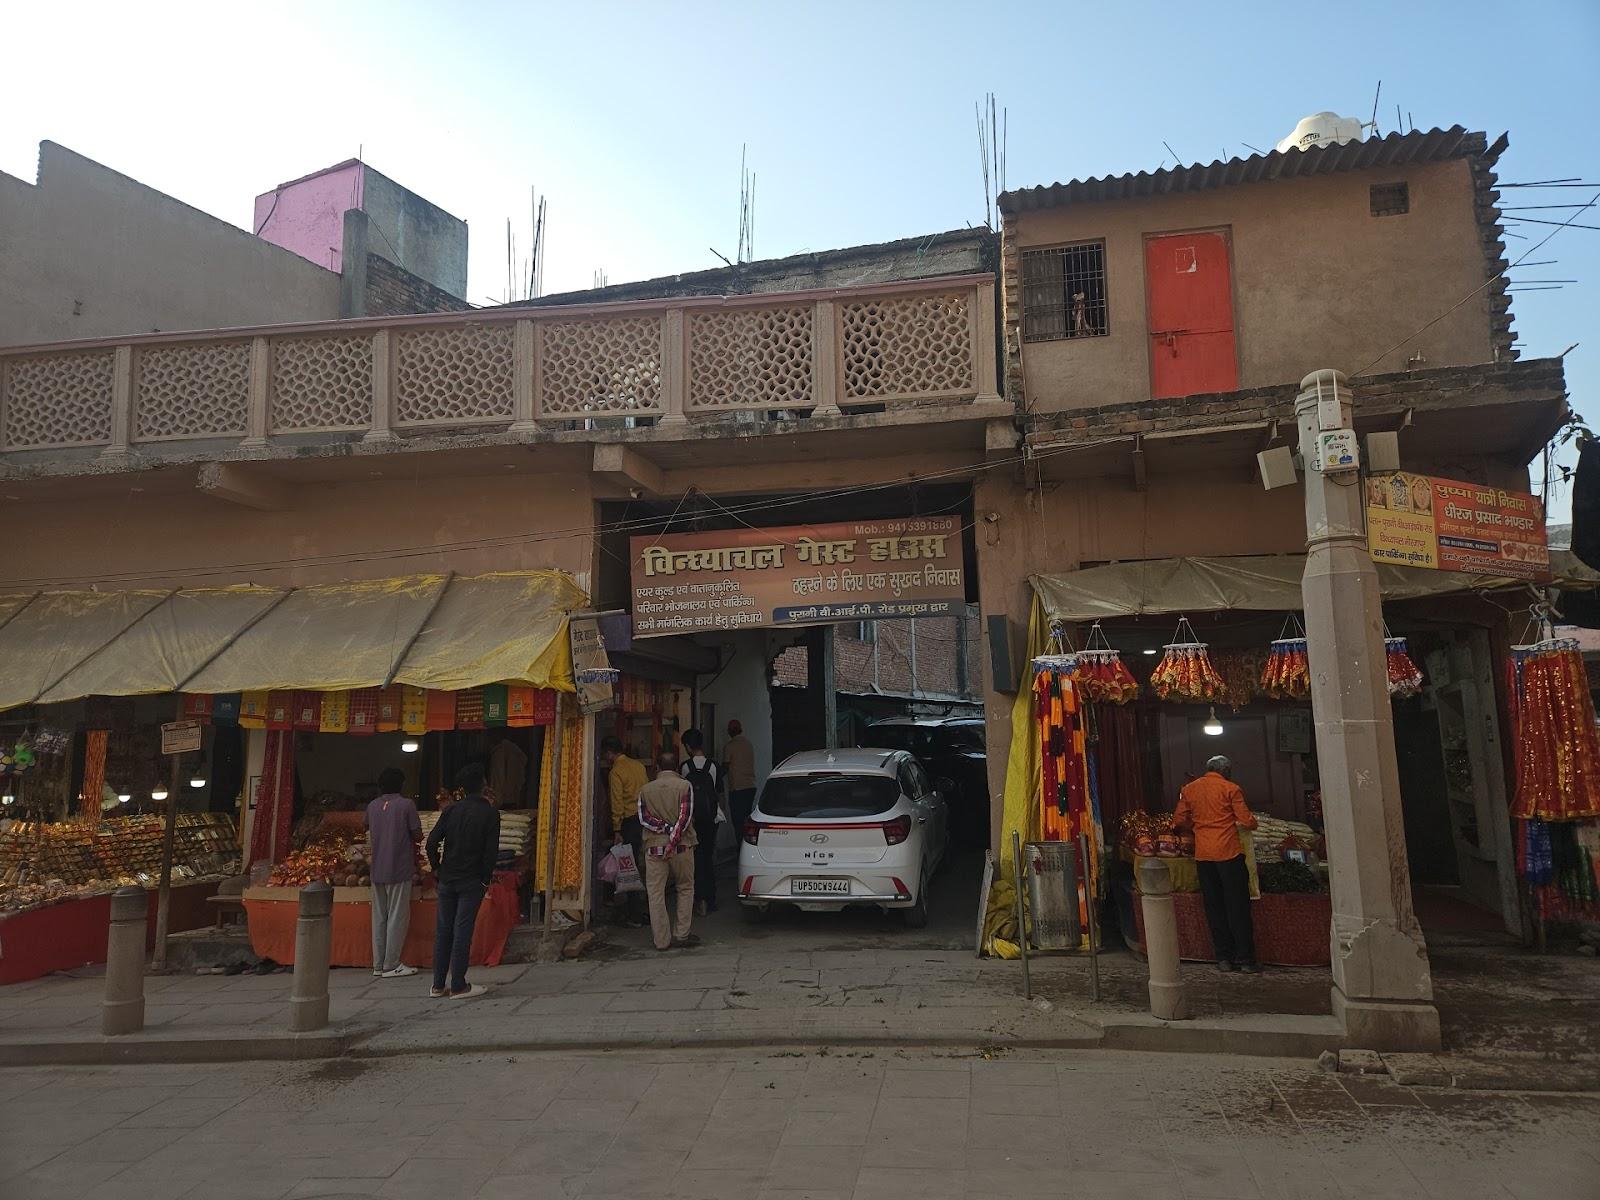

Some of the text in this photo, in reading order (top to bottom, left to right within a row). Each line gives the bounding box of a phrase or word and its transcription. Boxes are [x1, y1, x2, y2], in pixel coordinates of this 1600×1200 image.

[1474, 488, 1496, 507] यात्री
[1498, 490, 1527, 512] निवास
[1444, 501, 1534, 530] धीरज प्रसाद भण्डार
[855, 525, 885, 536] Mob.:
[640, 534, 949, 576] विन्ध्याचल गेस्ट हाउस
[792, 563, 961, 597] ठहरने के लिए एक सुखद निवास
[636, 587, 653, 598] एयर
[637, 602, 663, 614] परिवार
[665, 600, 707, 612] भोजनालय
[708, 597, 720, 610] एवं
[789, 607, 817, 622] पुरानी
[878, 603, 895, 614] रोड
[898, 604, 928, 616] प्रमुख
[930, 602, 948, 612] द्वार
[638, 618, 655, 630] सभी
[656, 616, 692, 629] मांगलिक
[694, 612, 713, 626] कार्य
[715, 612, 728, 629] हेतु
